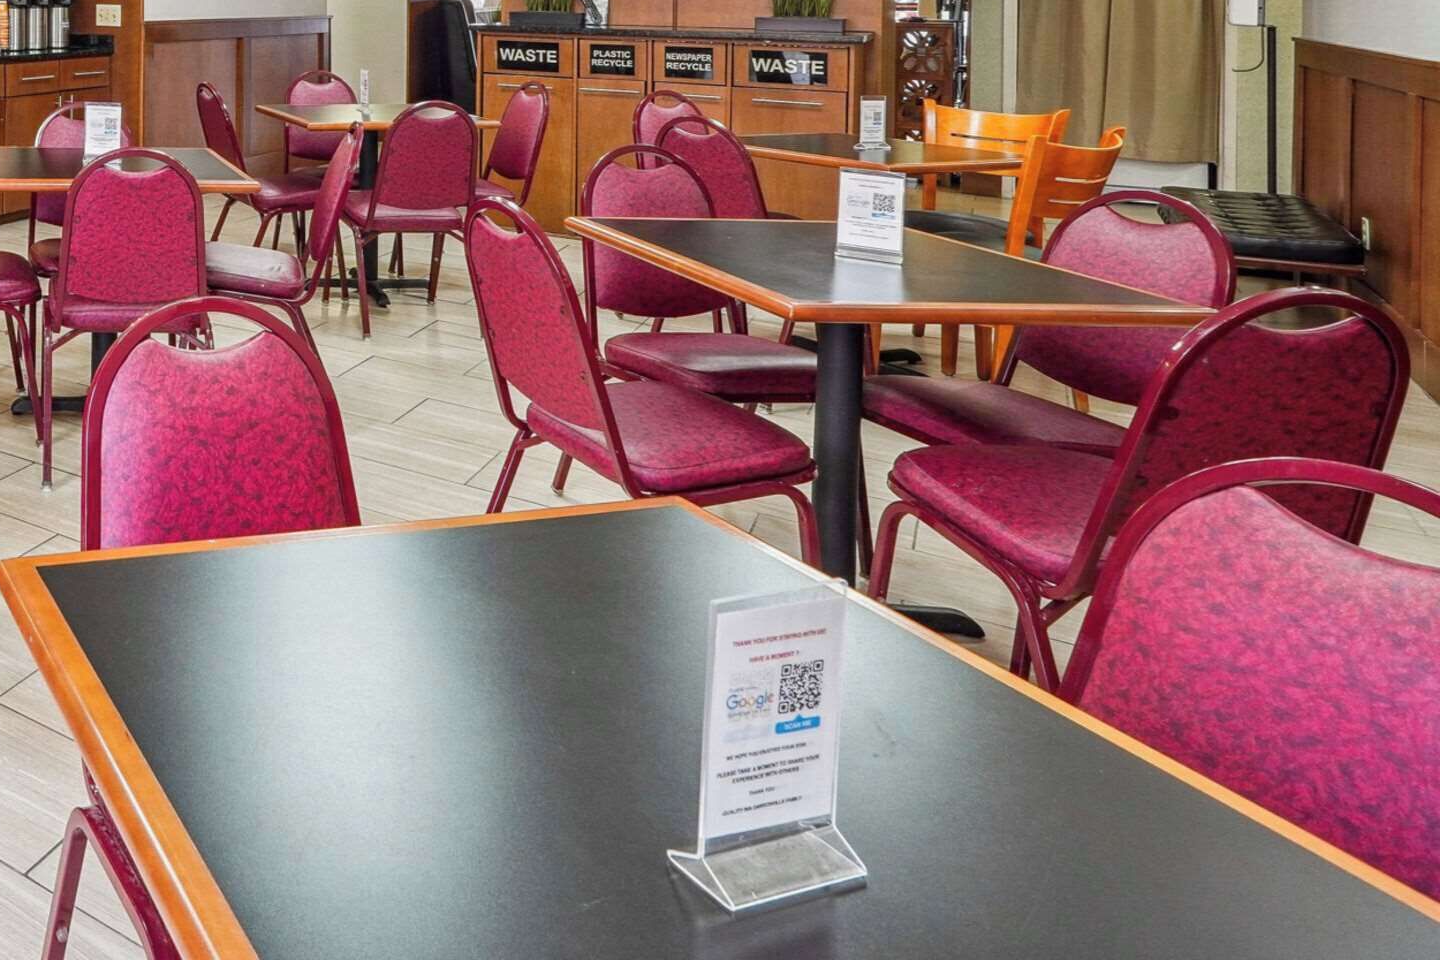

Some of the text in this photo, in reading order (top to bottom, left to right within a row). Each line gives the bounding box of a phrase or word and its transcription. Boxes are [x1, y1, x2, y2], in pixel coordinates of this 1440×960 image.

[499, 47, 558, 64] WASTE
[593, 49, 631, 59] PLASTIC
[665, 52, 712, 62] NEWSPAPER
[591, 58, 633, 68] RECYCLE
[665, 61, 712, 72] RECYCLE
[752, 57, 824, 76] WASTE
[726, 689, 774, 710] Google
